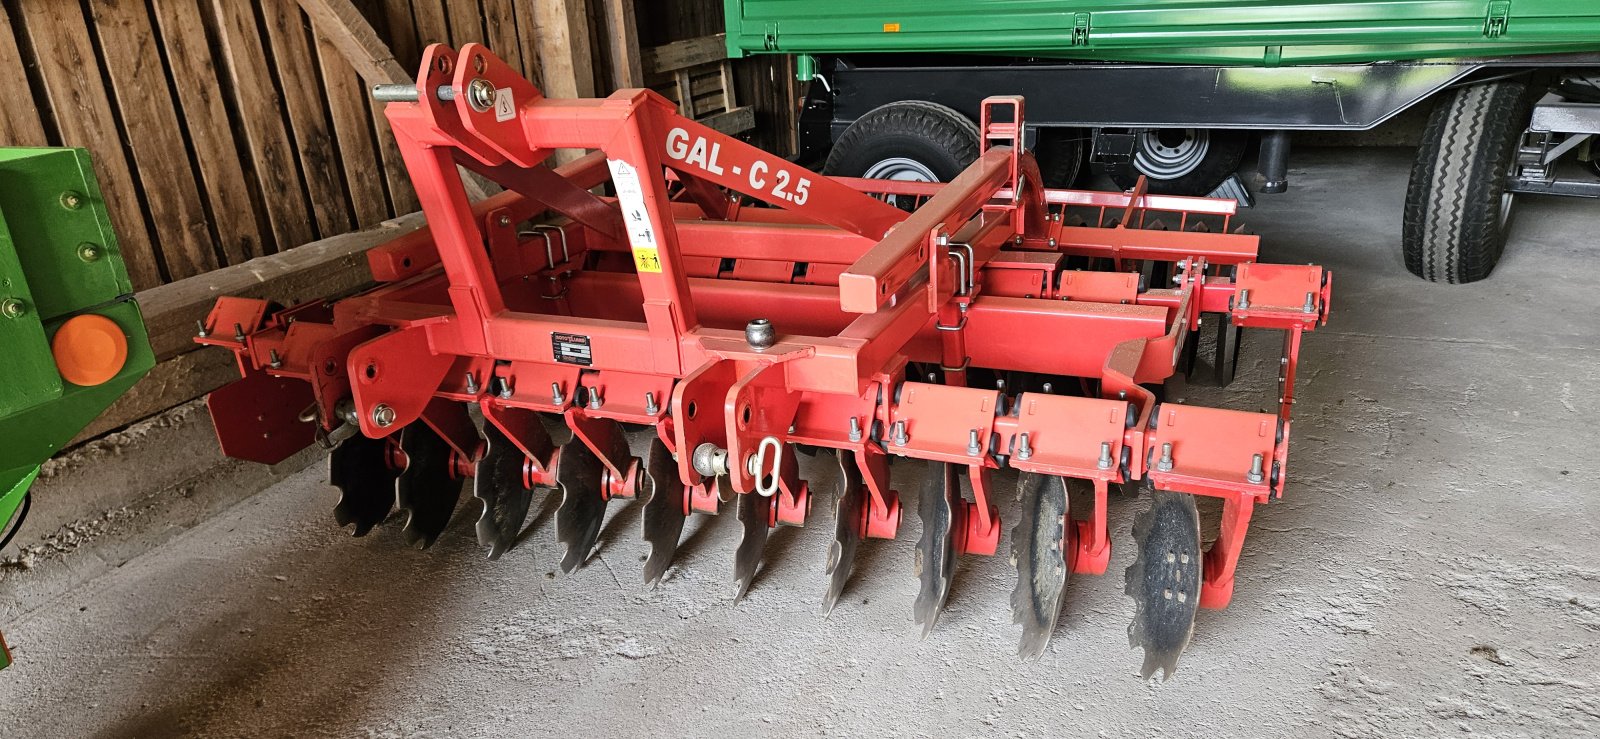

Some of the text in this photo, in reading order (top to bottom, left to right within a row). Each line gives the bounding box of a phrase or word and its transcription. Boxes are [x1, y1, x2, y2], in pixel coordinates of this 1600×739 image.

[666, 127, 811, 206] GAL - C 2.5
